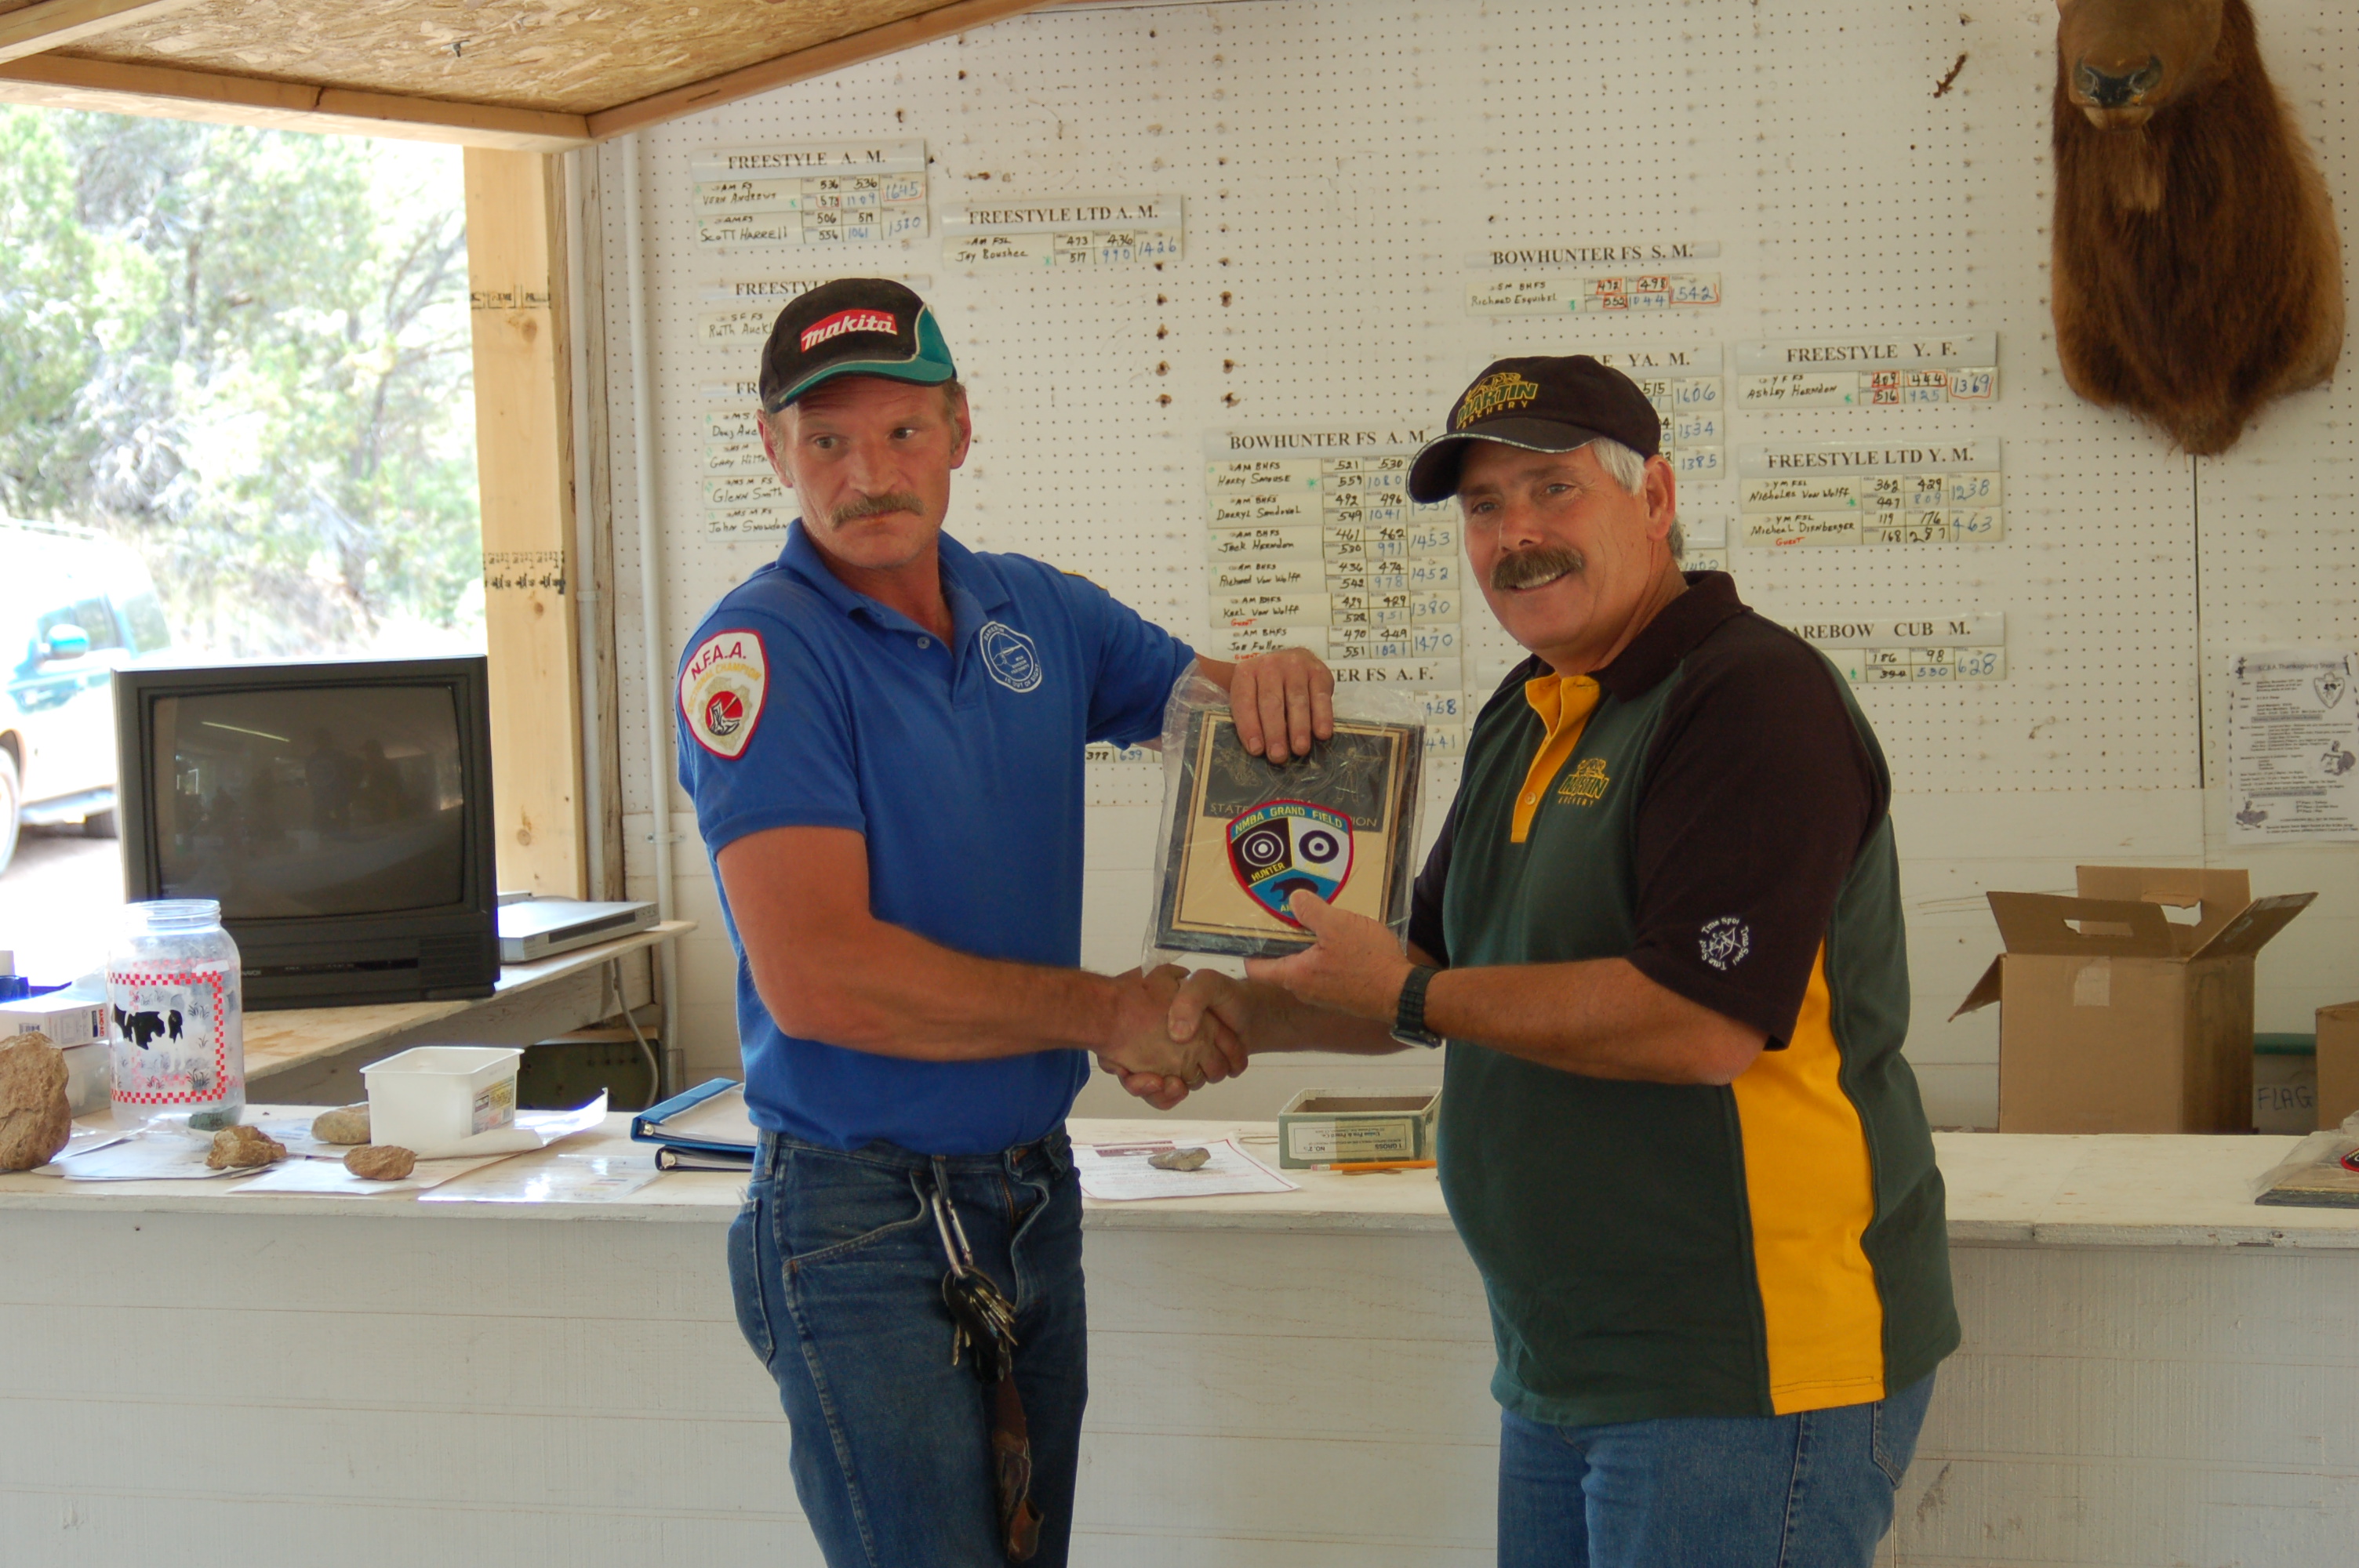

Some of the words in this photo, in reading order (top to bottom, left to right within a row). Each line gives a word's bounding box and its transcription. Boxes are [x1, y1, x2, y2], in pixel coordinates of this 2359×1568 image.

[729, 152, 827, 169] FREESTYLE
[820, 180, 838, 189] 536
[853, 178, 878, 190] 536
[969, 208, 1070, 224] FREESTYLE
[1077, 207, 1111, 220] LTD
[1067, 236, 1088, 245] 473
[1139, 236, 1176, 256] 1426
[1493, 246, 1615, 265] BOWHUNTER
[1622, 246, 1641, 260] FS
[1629, 296, 1666, 307] 1044
[801, 314, 897, 351] makita
[1787, 344, 1898, 362] FREESTYLE
[1954, 374, 1990, 394] 1369
[1677, 384, 1716, 404] 1606
[1456, 383, 1539, 429] MARTIN
[1679, 422, 1714, 439] 1534
[1230, 432, 1350, 450] BOWHUNTER
[1357, 432, 1376, 445] FS
[1387, 432, 1403, 445] A.
[1335, 459, 1358, 470] 521
[1378, 459, 1403, 470] 530
[1768, 450, 1879, 468] FREESTYLE
[1885, 448, 1922, 464] LTD
[1368, 475, 1402, 488] 1080
[1917, 478, 1942, 492] 429
[1952, 479, 1990, 501] 1238
[1336, 493, 1358, 506] 492
[1380, 493, 1402, 506] 496
[1337, 510, 1362, 522] 549
[1370, 510, 1400, 521] 1041
[1921, 511, 1941, 524] 176
[1380, 528, 1405, 540] 462
[1954, 513, 1992, 541] 463
[1336, 528, 1360, 541] 461
[1412, 532, 1450, 550] 1453
[1882, 530, 1901, 543] 168
[1910, 527, 1945, 543] 287
[1338, 543, 1361, 554] 530
[1378, 542, 1401, 556] 991
[1339, 562, 1363, 572] 436
[1379, 562, 1405, 575] 474
[1375, 575, 1403, 588] 978
[1412, 568, 1448, 582] 1452
[1383, 595, 1406, 608] 429
[1412, 601, 1450, 616] 1380
[1377, 611, 1402, 622] 951
[1343, 629, 1366, 641] 470
[1380, 629, 1407, 642] 449
[1894, 622, 1933, 637] CUB
[1949, 621, 1971, 635] M.
[1376, 642, 1405, 656] 1021
[1415, 634, 1453, 652] 1470
[1343, 646, 1365, 658] 551
[1926, 649, 1944, 662] 98
[1958, 653, 1997, 675] 628
[1367, 668, 1387, 681] FS
[1397, 668, 1412, 681] A.
[1419, 667, 1434, 680] F.
[1917, 667, 1947, 677] 530
[1235, 811, 1265, 834] NMBA
[1270, 806, 1305, 818] GRAND
[1312, 811, 1343, 829] FIELD
[1251, 862, 1285, 881] HUNTER
[2258, 1086, 2313, 1110] FLAG
